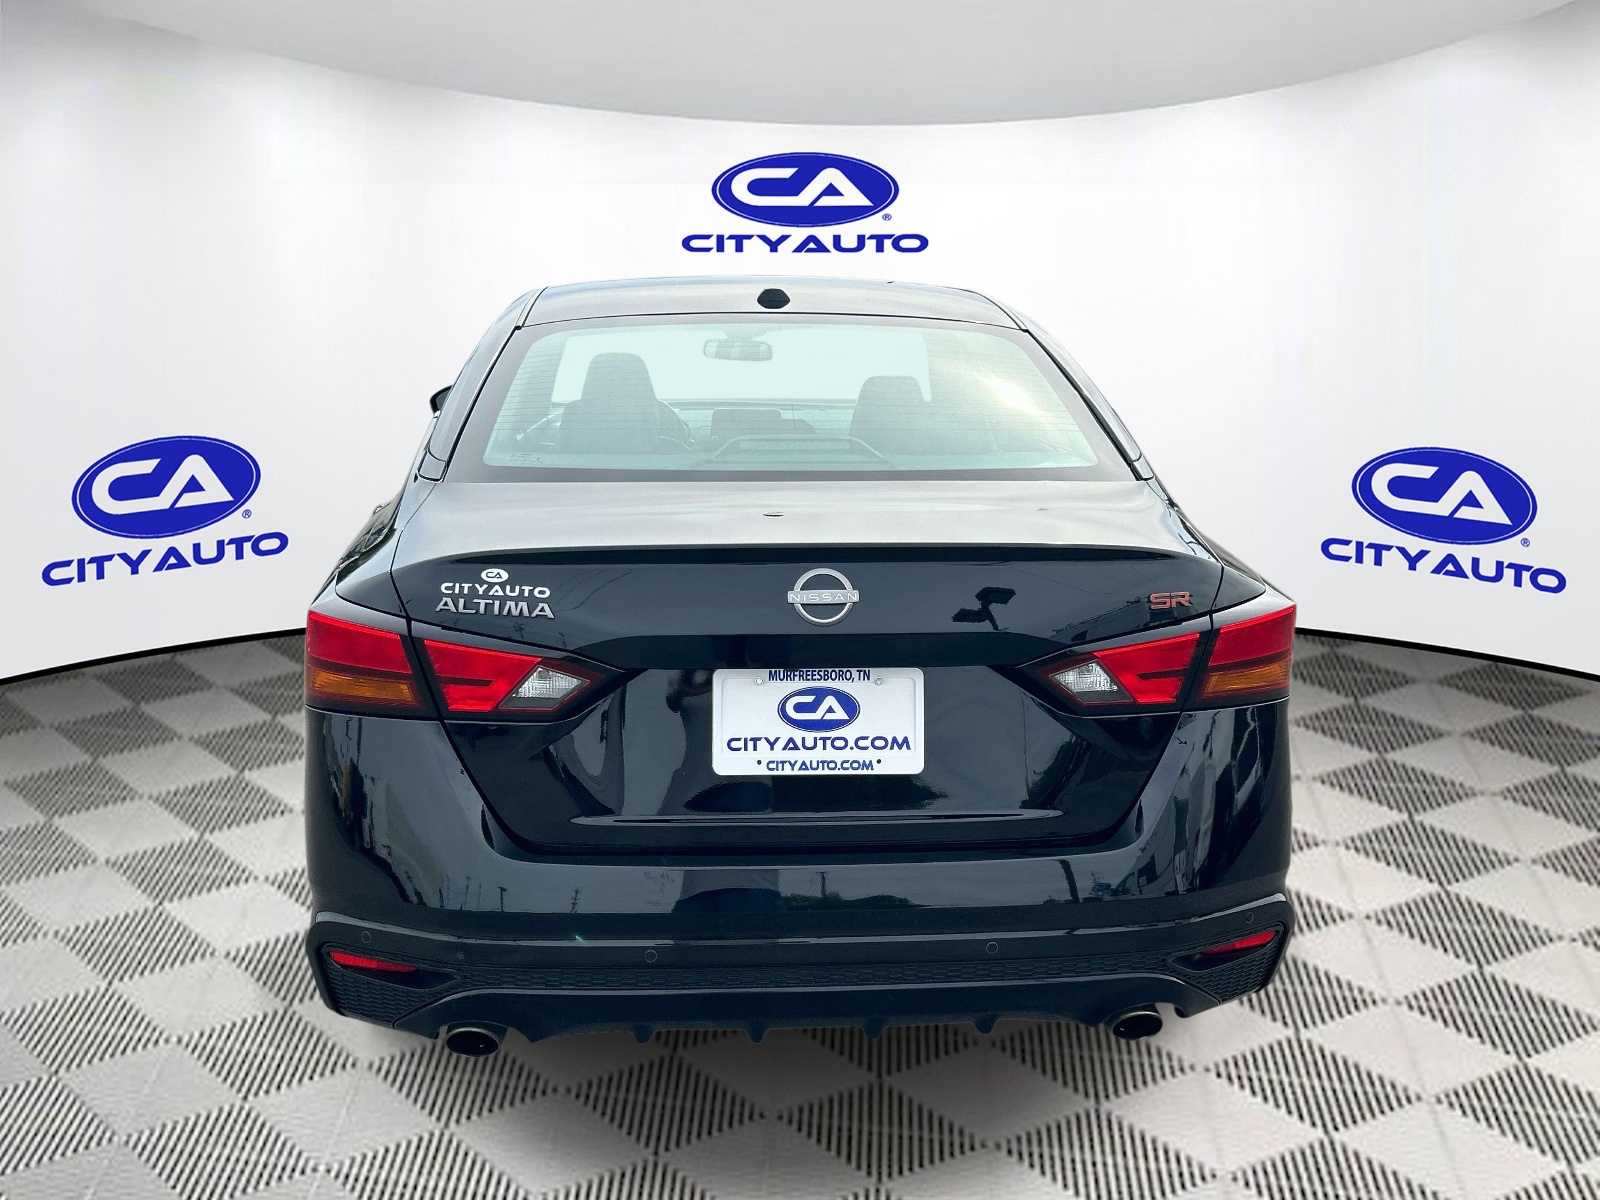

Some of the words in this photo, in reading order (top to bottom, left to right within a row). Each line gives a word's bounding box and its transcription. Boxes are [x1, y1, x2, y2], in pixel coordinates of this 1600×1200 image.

[731, 167, 874, 207] CA
[92, 454, 235, 515] CA
[1371, 462, 1513, 526] CA
[789, 592, 858, 602] NISSAN
[1150, 591, 1192, 609] SR
[435, 597, 555, 619] ALTIMA
[768, 669, 855, 682] MURFREESBORO,
[857, 669, 871, 681] TN
[785, 695, 850, 720] CA
[726, 735, 912, 752] CITYAUTO.COM
[766, 759, 874, 771] CITYAUTO.COM
